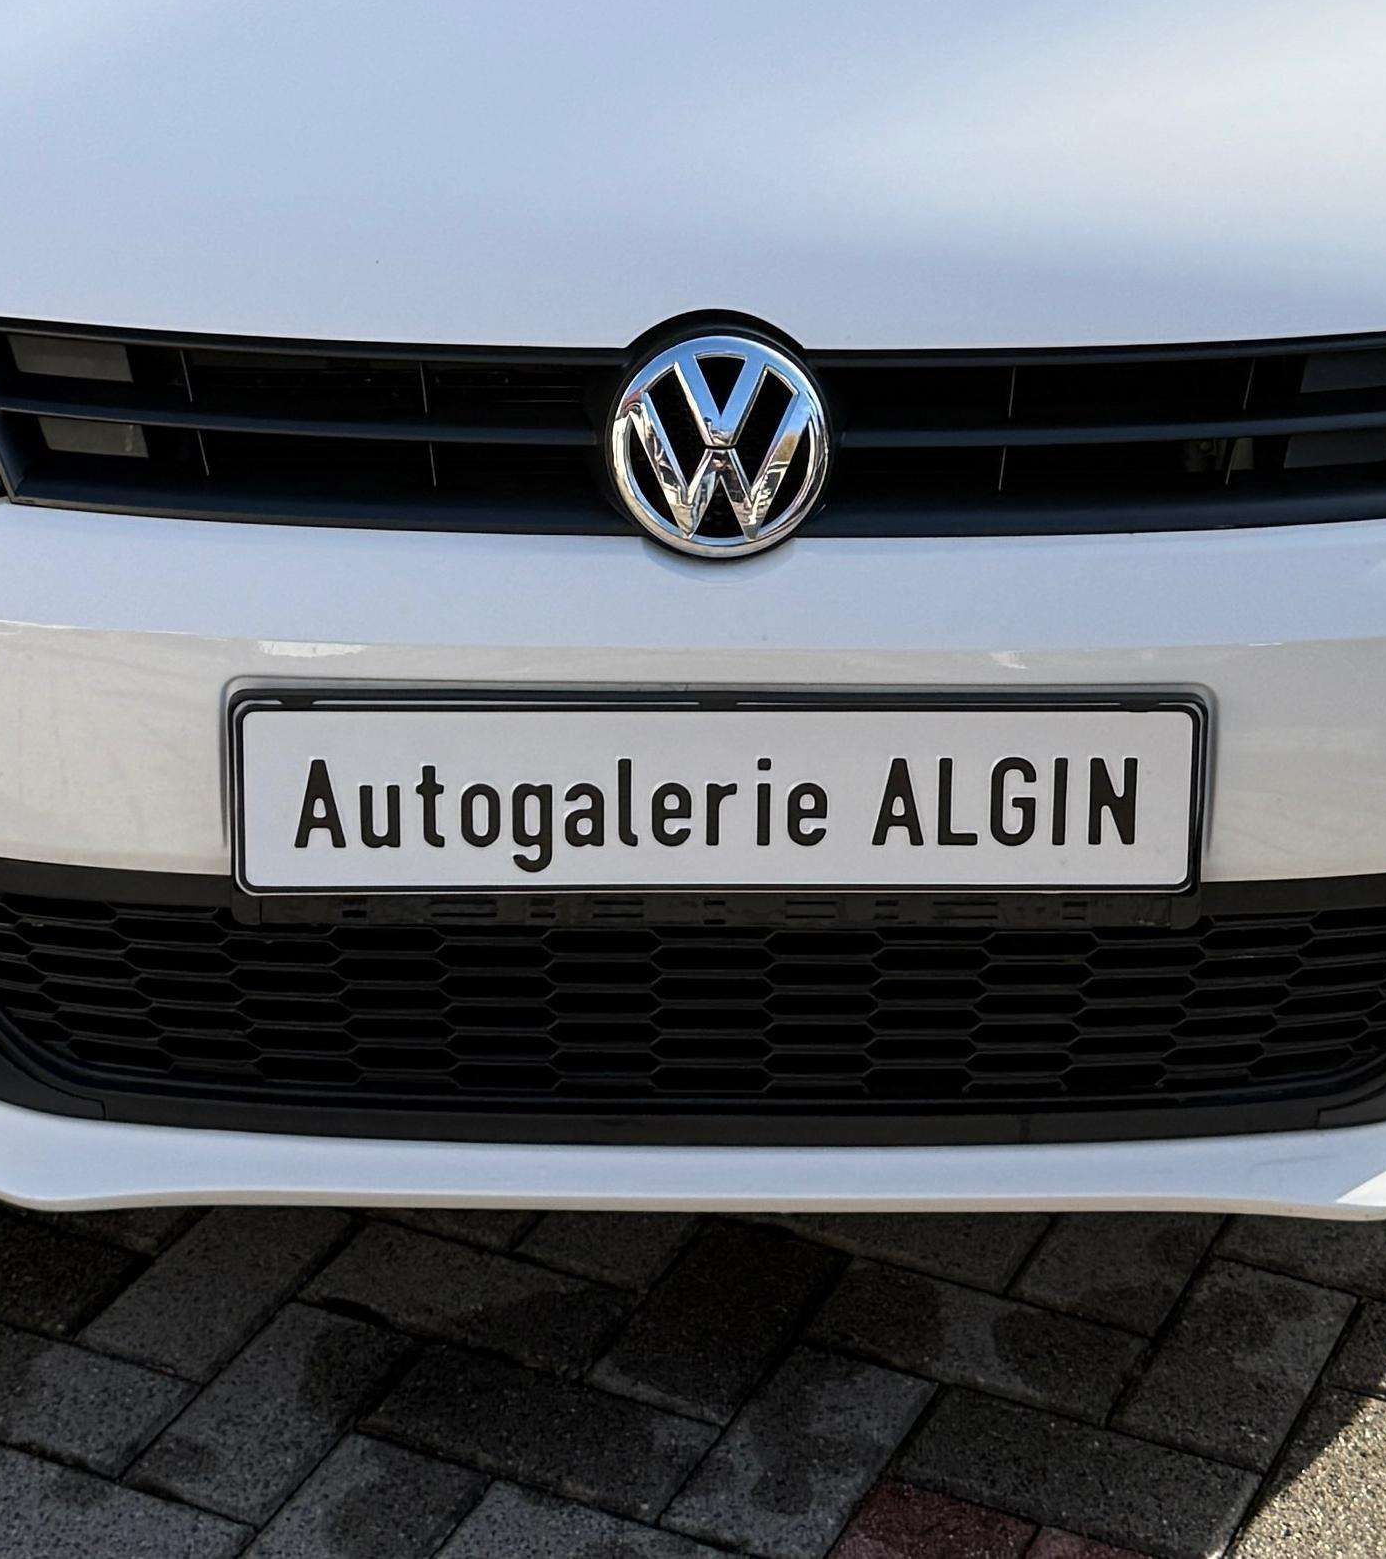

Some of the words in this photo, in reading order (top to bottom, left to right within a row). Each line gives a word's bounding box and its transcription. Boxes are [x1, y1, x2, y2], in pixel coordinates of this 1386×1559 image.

[616, 340, 823, 550] VW
[294, 756, 829, 873] Autogalerie
[871, 755, 1139, 848] ALGIN
